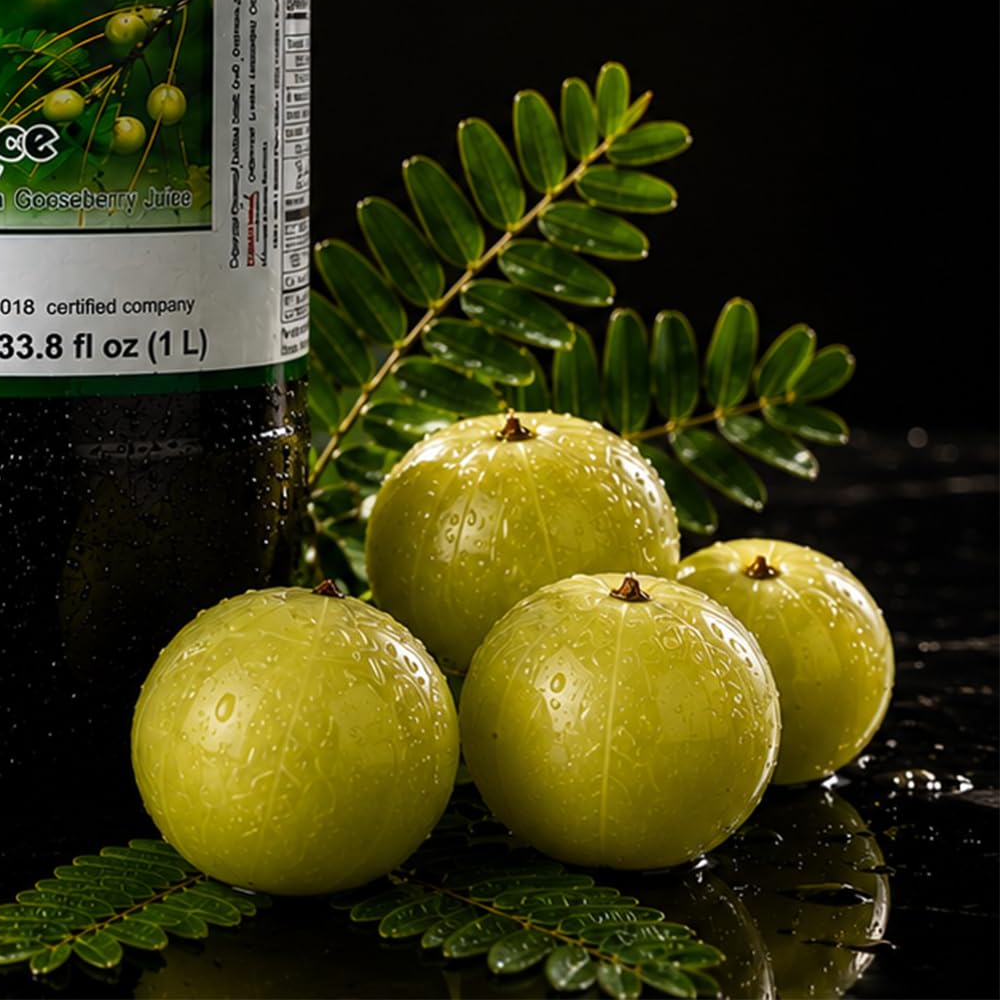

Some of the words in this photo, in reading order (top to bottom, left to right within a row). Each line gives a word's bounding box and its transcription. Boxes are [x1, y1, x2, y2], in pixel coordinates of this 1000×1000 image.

[14, 186, 138, 216] Gooseberry
[46, 297, 117, 315] certified
[122, 298, 196, 317] company
[73, 333, 93, 359] fl
[102, 339, 139, 359] oz
[147, 331, 172, 364] (1
[182, 329, 209, 361] L)
